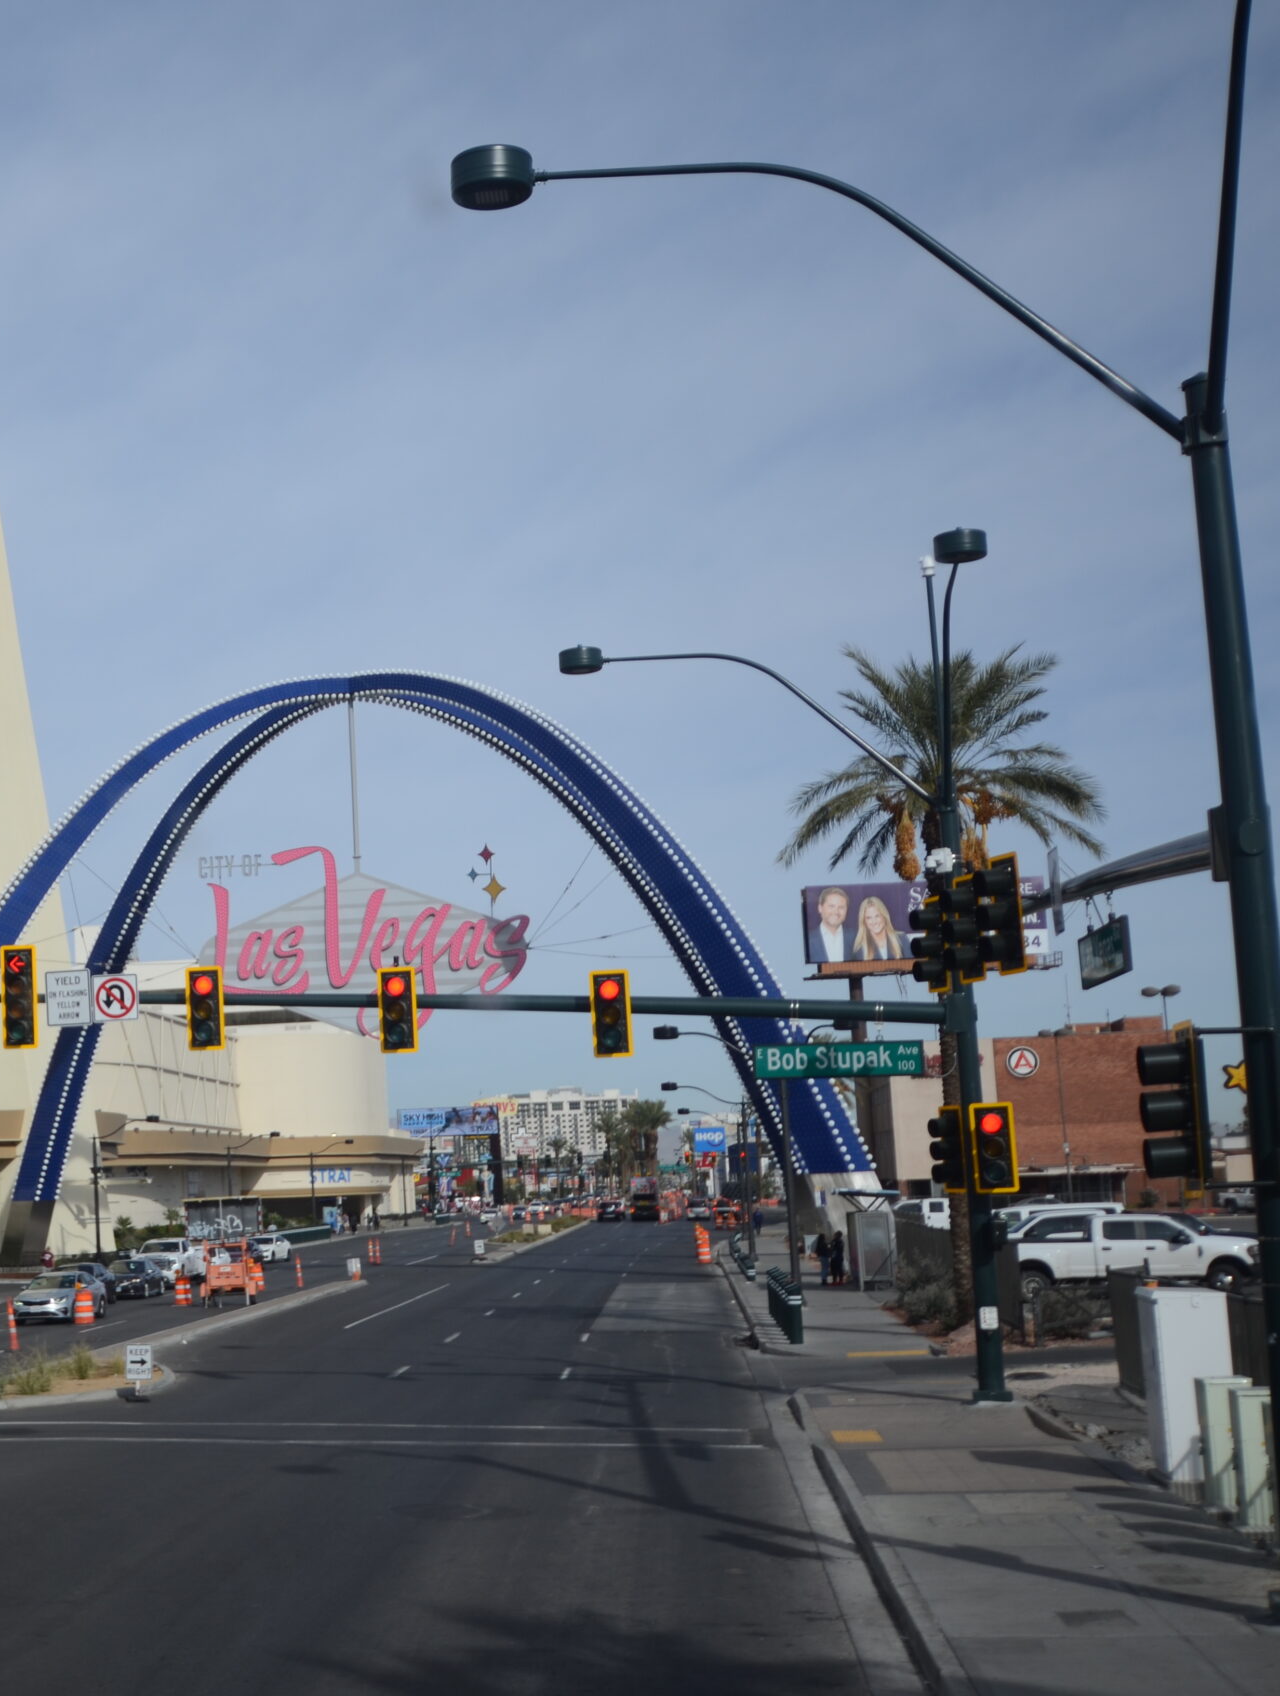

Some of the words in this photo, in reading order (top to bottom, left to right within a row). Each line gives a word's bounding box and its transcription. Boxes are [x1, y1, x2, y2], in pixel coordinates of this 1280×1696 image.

[198, 856, 235, 879] CITY
[242, 854, 262, 877] OF
[207, 883, 310, 996] Las
[270, 846, 531, 1040] Vegas
[54, 975, 81, 986] YIELD
[58, 988, 88, 998] FLASHING
[56, 1001, 81, 1009] YELLOW
[58, 1011, 80, 1019] ARROW
[756, 1048, 764, 1059] E
[767, 1048, 809, 1071] Bob
[815, 1046, 893, 1073] Stupak
[897, 1044, 920, 1056] Ave
[897, 1059, 916, 1071] 100
[309, 1167, 352, 1185] STRAT
[129, 1348, 150, 1356] KEEP
[128, 1367, 151, 1376] RIGHT
